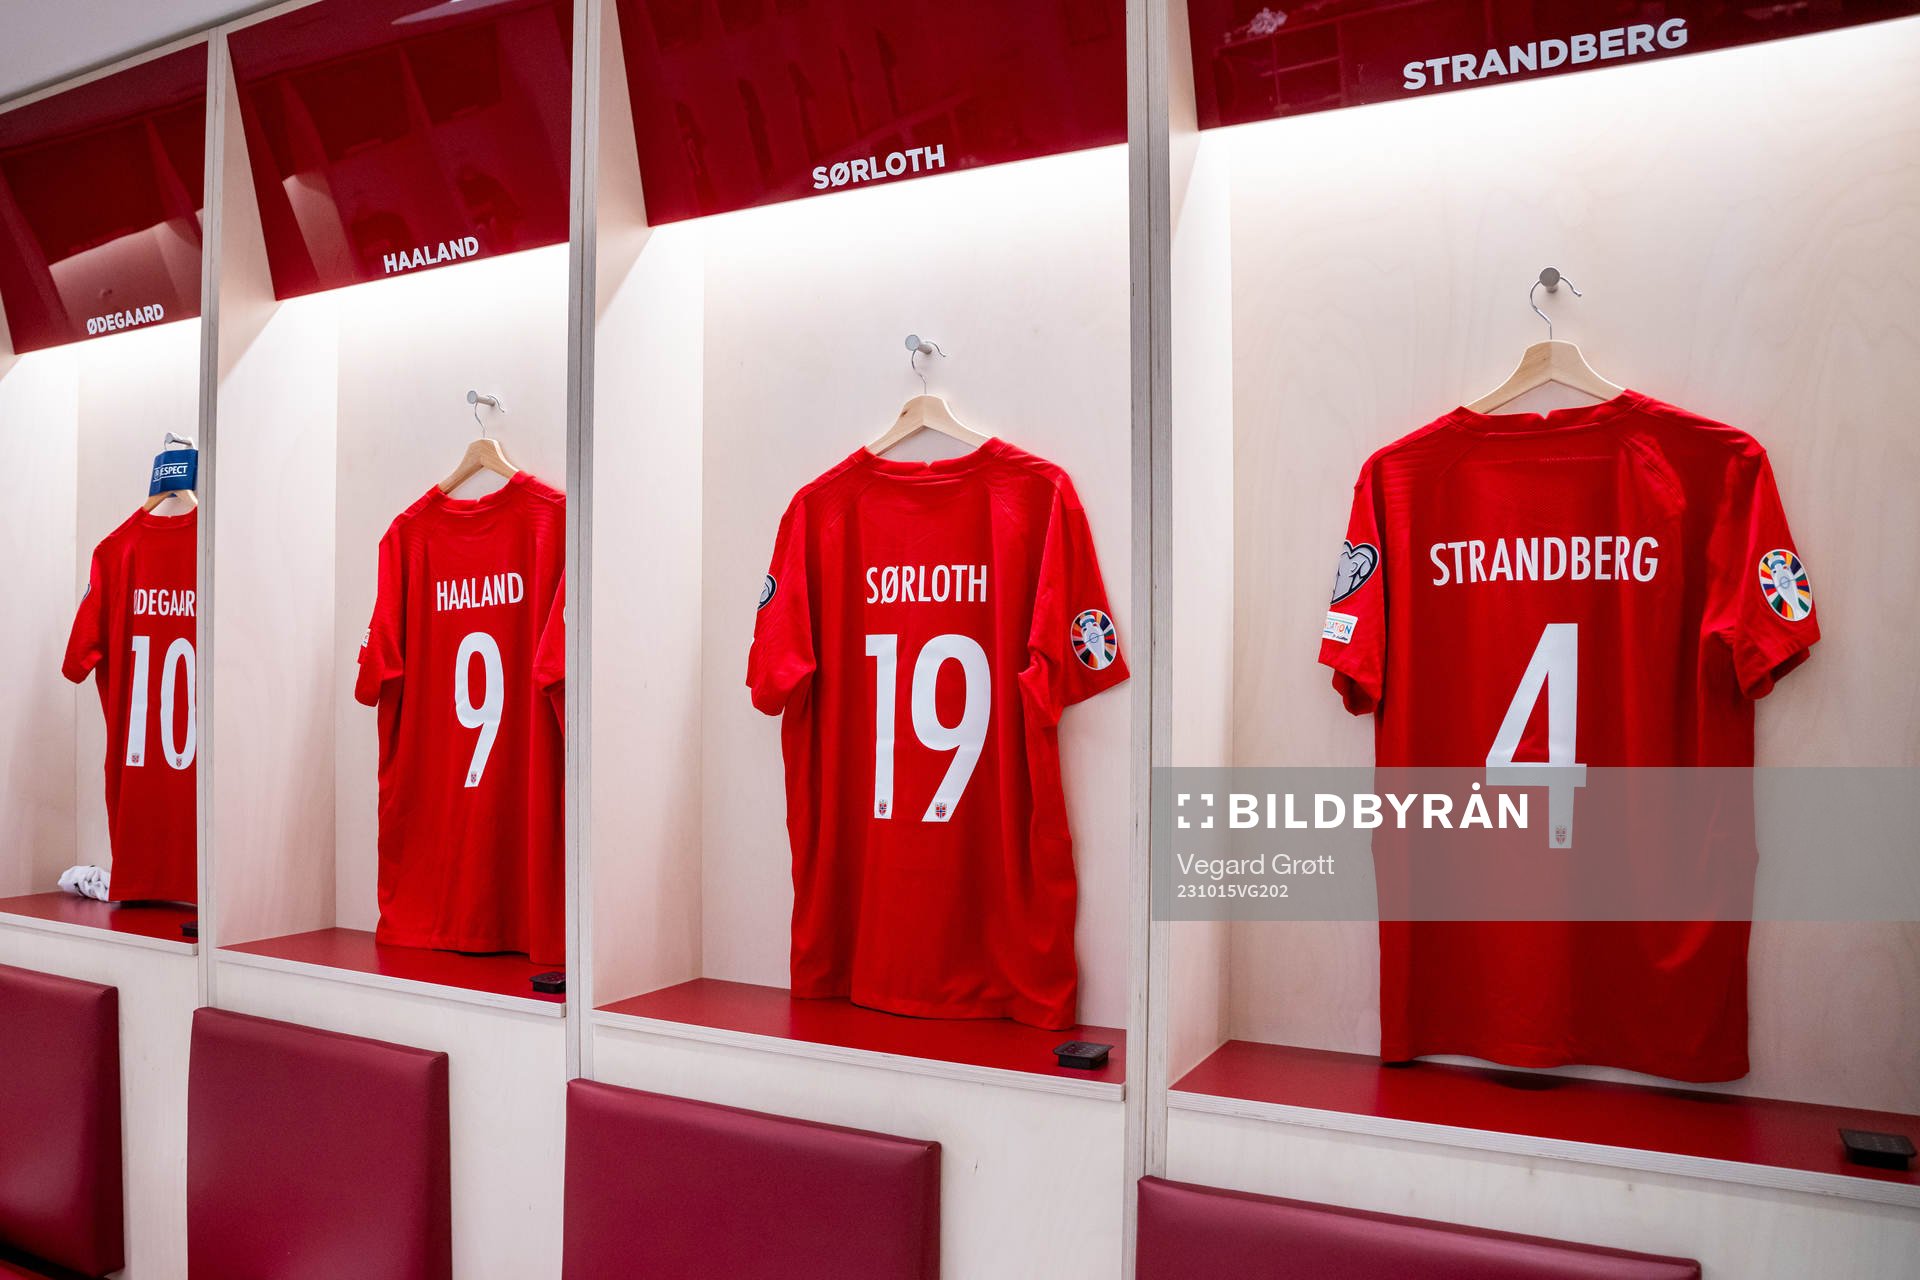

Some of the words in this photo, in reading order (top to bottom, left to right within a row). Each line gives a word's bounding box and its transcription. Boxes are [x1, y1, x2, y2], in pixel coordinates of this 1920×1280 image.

[1403, 18, 1688, 90] STRANDBERG
[812, 144, 946, 190] SØRLOTH
[383, 236, 479, 273] HAALAND
[86, 303, 164, 335] ØDEGAARD
[866, 564, 988, 605] SØRLOTH
[1430, 536, 1659, 586] STRANDBERG
[436, 572, 524, 612] HAALAND
[126, 636, 196, 770] 10
[455, 632, 504, 788] 9
[865, 634, 992, 822] 19
[1486, 623, 1587, 849] 4
